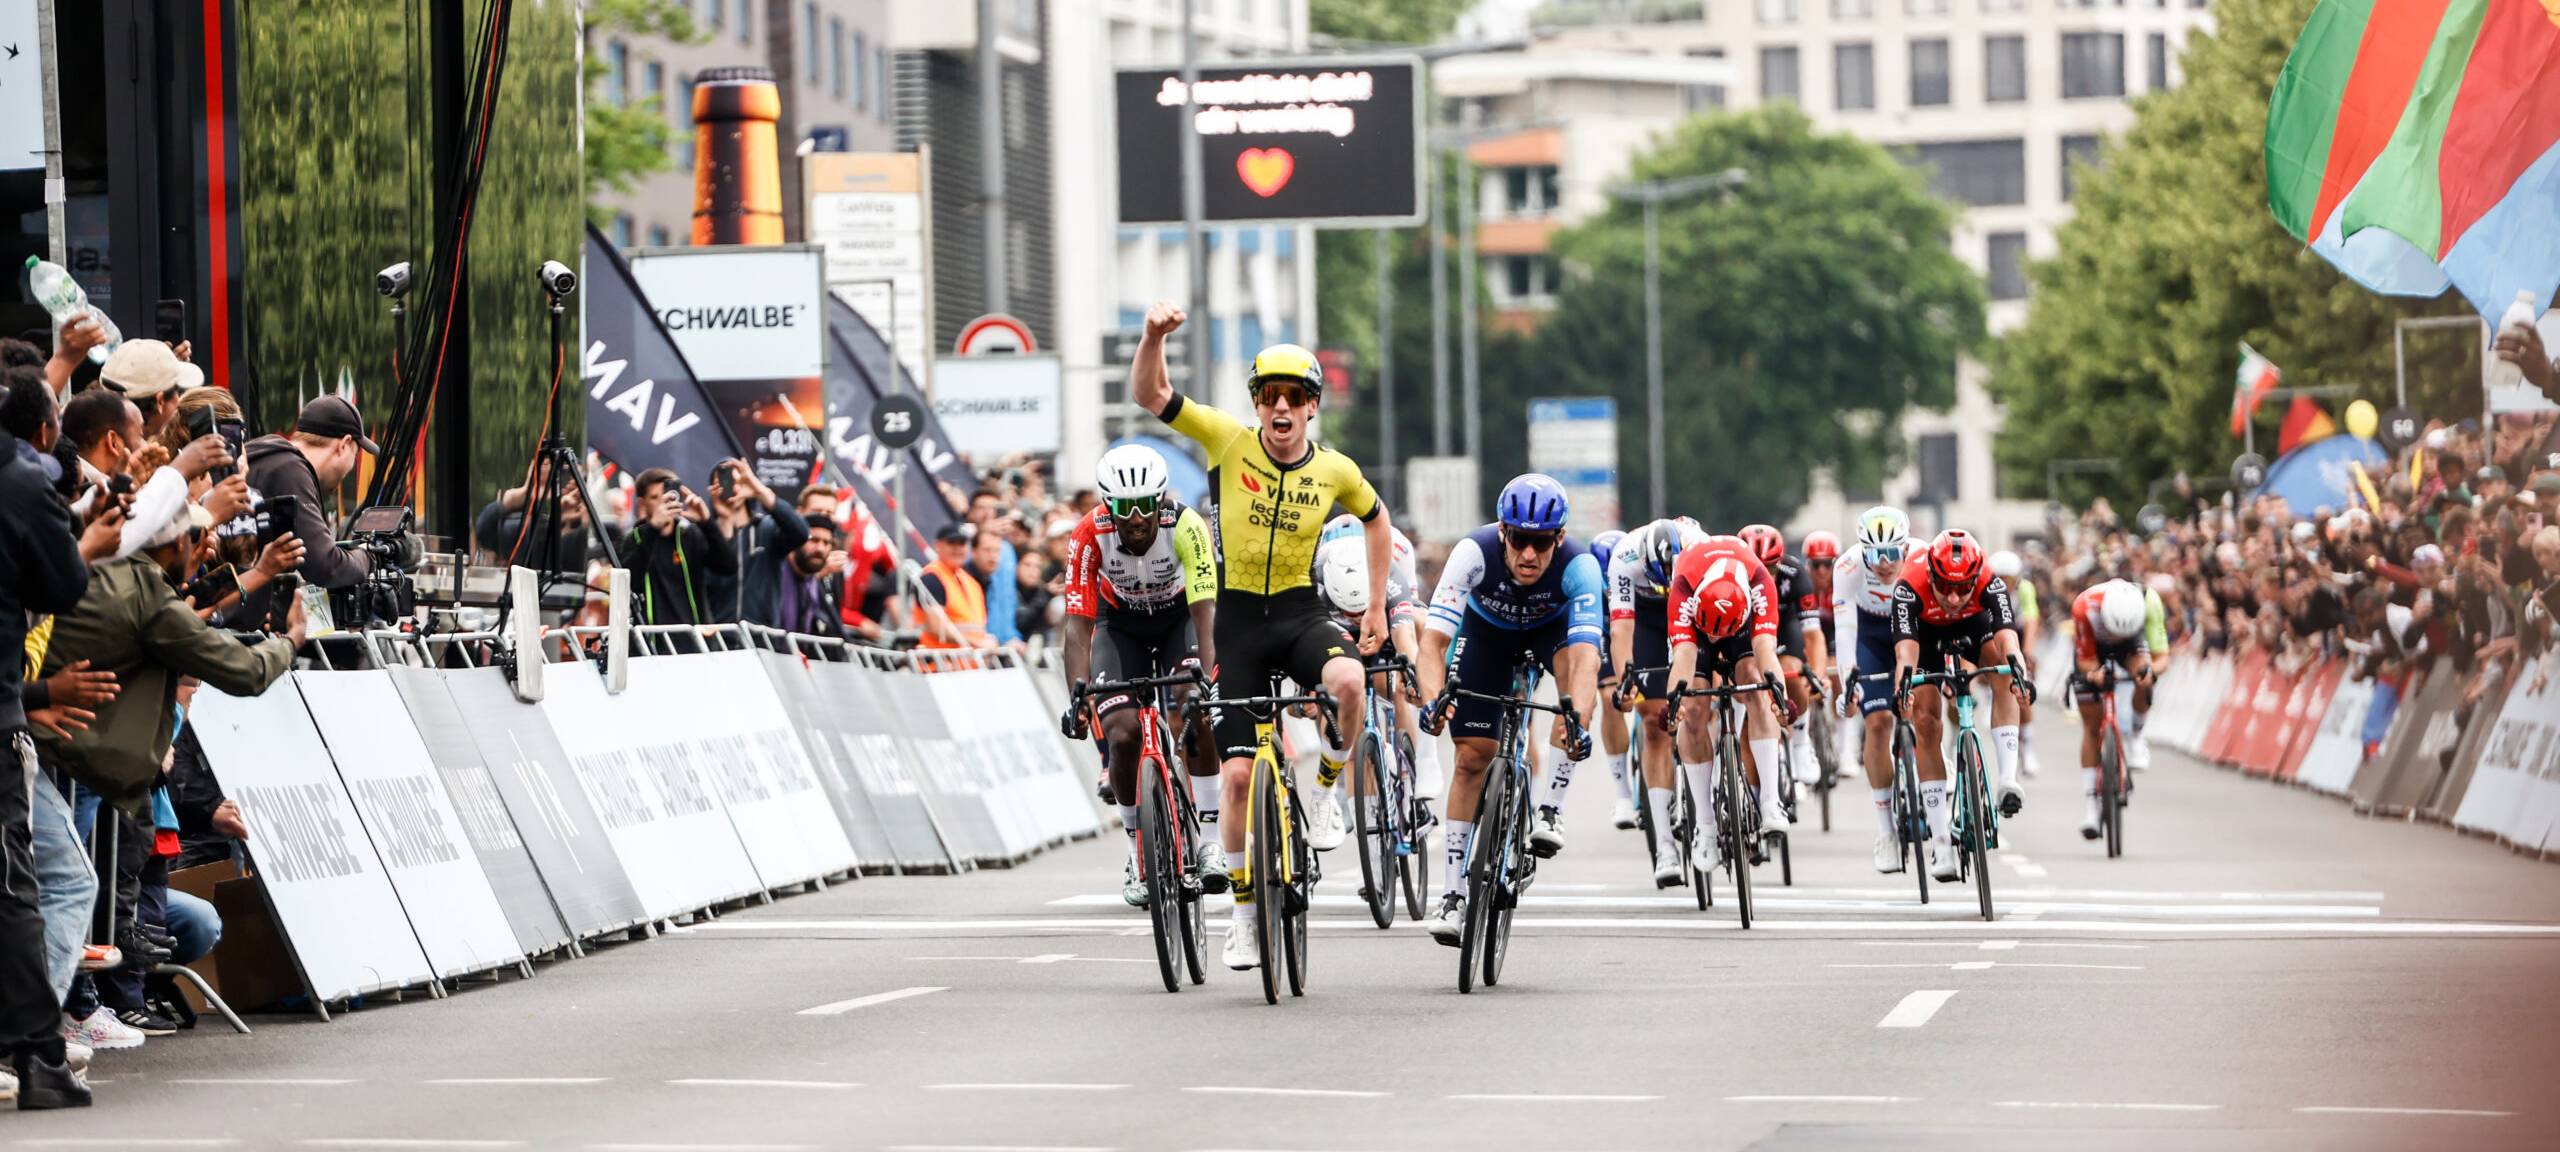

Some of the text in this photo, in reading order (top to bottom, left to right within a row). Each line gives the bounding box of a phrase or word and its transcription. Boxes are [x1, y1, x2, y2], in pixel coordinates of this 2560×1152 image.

[656, 305, 795, 330] CHWALBE
[884, 411, 911, 433] 25
[1251, 499, 1301, 520] lease
[1267, 485, 1320, 507] VISMA
[1618, 574, 1631, 602] BOSS
[1751, 583, 1768, 616] lotto
[1673, 595, 1701, 628] lotto
[236, 782, 364, 883] SCHWALBE
[356, 775, 461, 869] SCHWALBE
